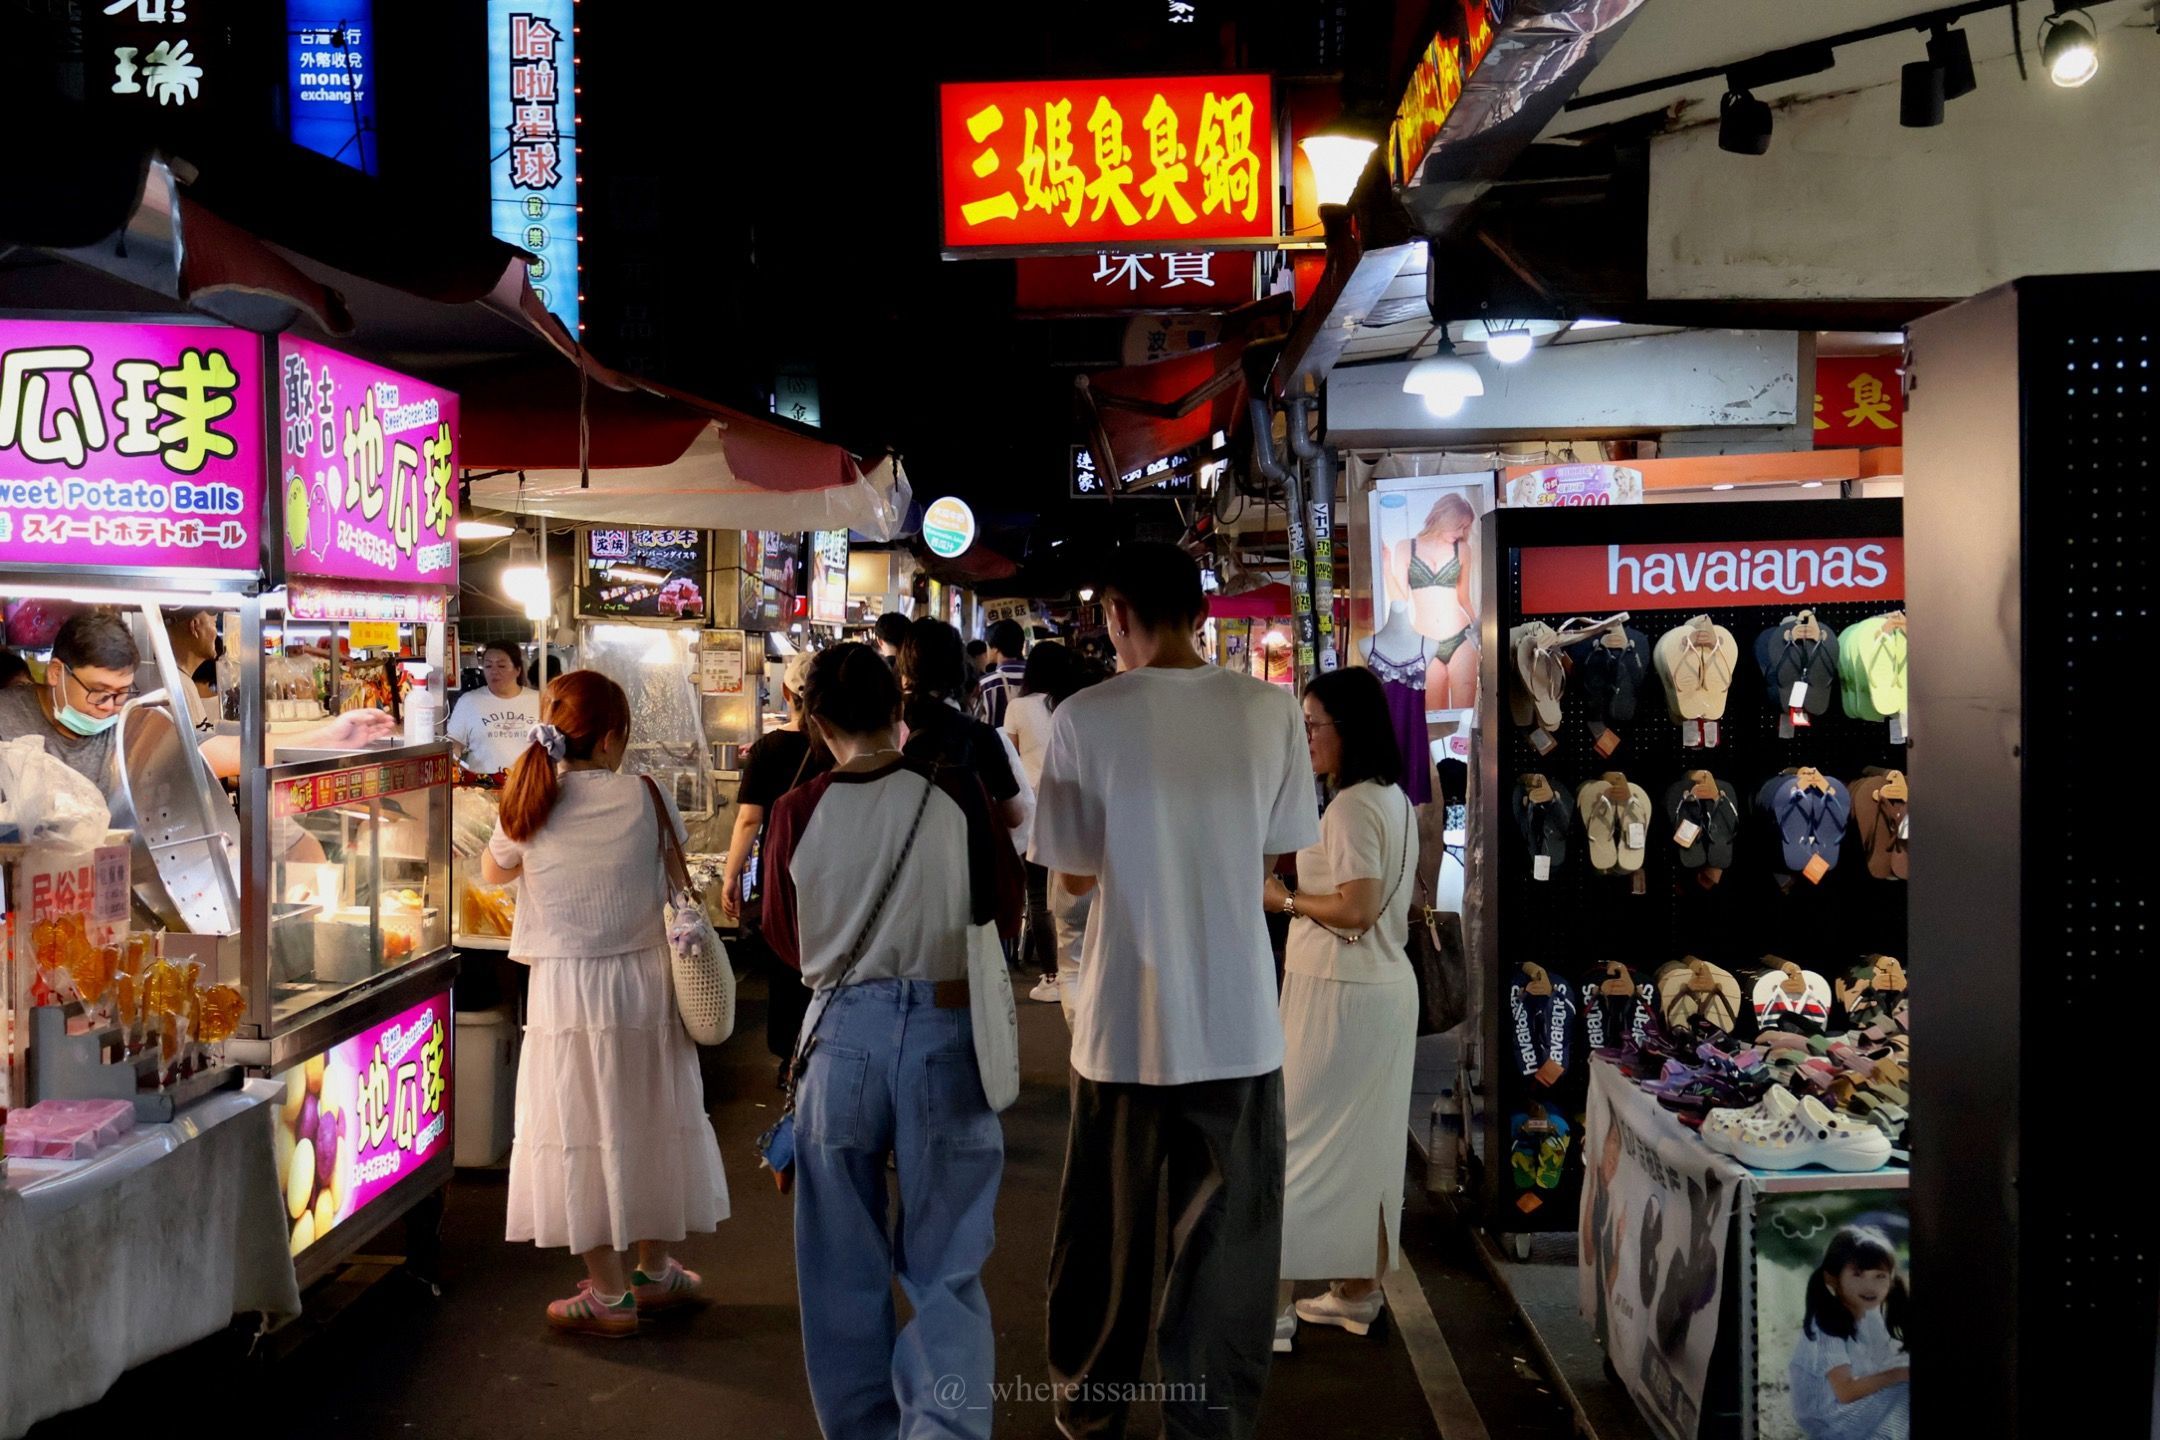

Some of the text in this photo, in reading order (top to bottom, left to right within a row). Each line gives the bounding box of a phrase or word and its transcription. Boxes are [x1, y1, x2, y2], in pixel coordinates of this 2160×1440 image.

[300, 28, 362, 45] 台灣行
[300, 73, 363, 90] money
[511, 15, 558, 187] 哈啦星球
[961, 92, 1260, 227] 三媽臭臭鍋
[0, 482, 241, 512] weet Potato Balls
[343, 385, 454, 560] 地瓜球
[1608, 544, 1888, 596] havaianas
[487, 730, 529, 739] WORLDWID
[356, 1018, 445, 1154] 地瓜球
